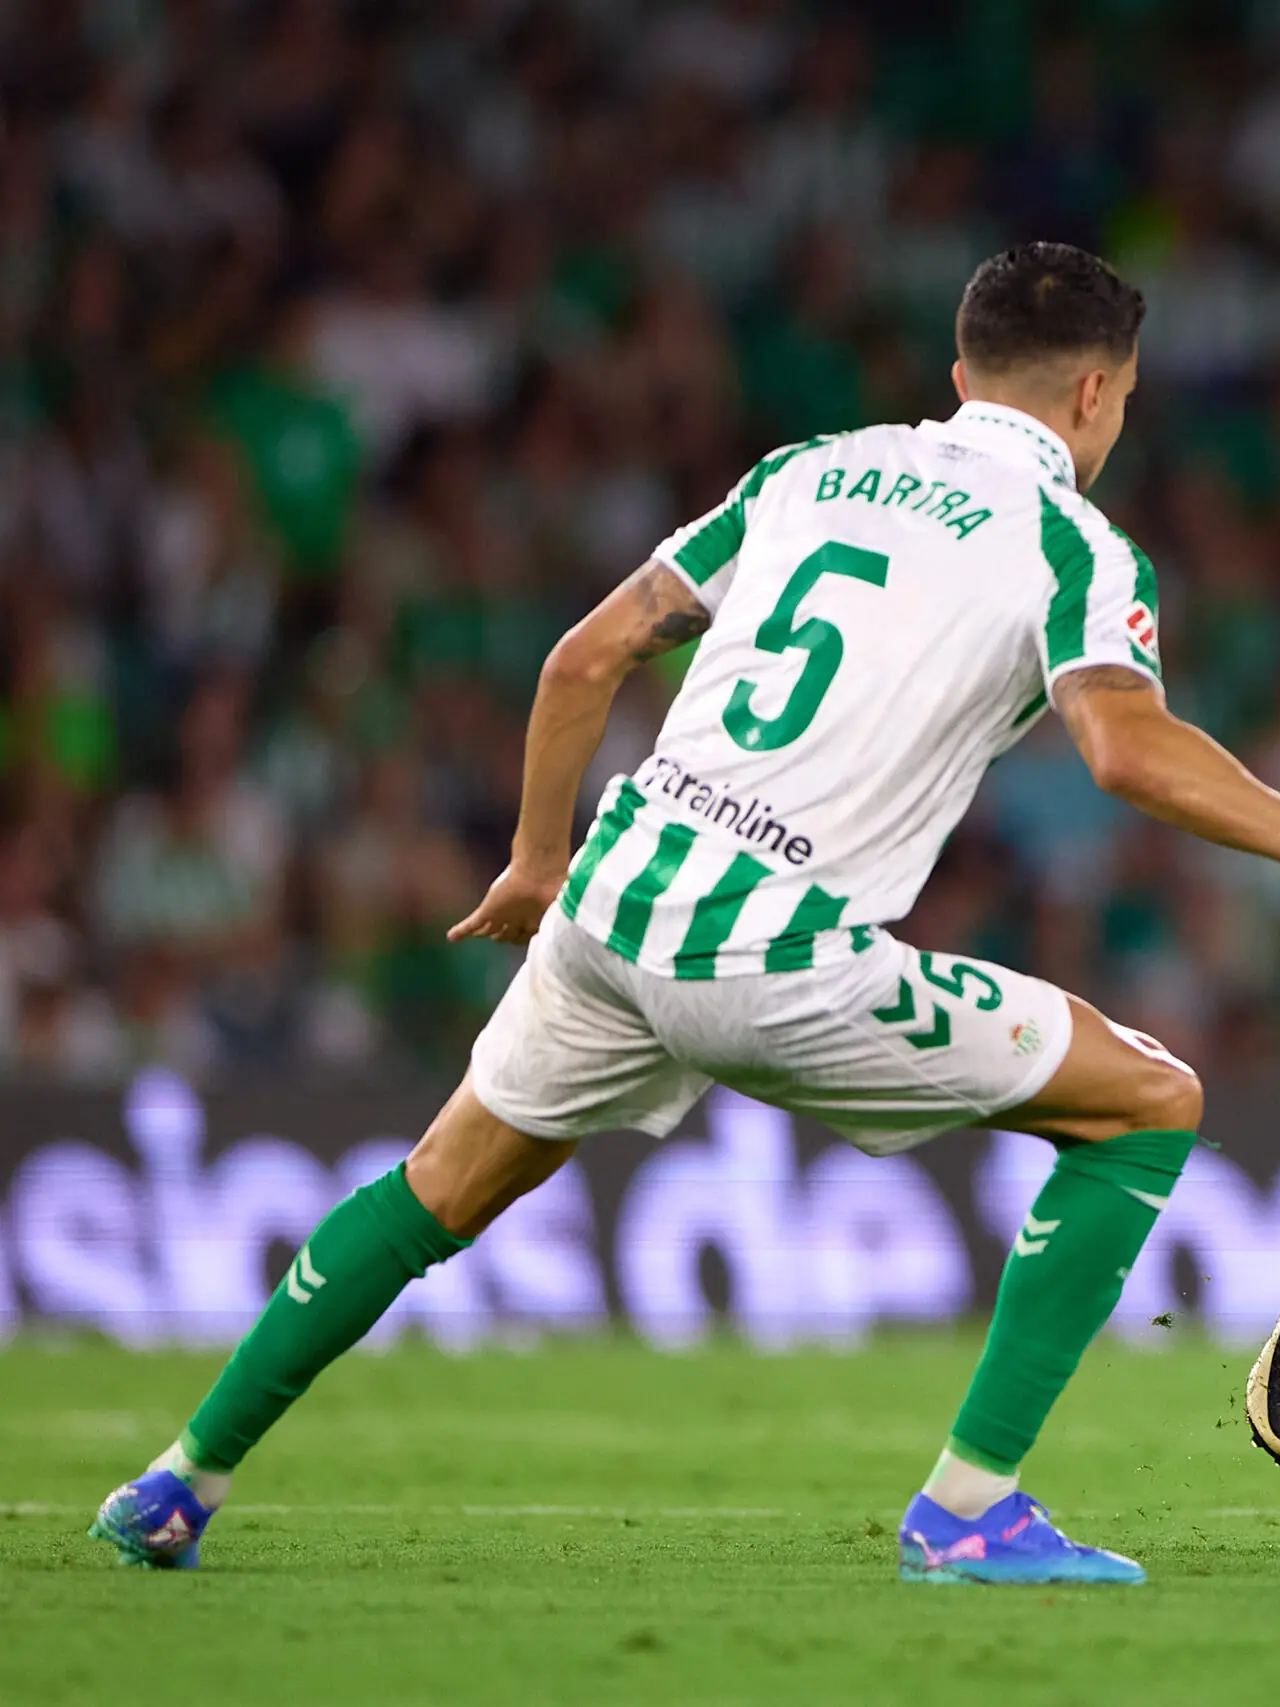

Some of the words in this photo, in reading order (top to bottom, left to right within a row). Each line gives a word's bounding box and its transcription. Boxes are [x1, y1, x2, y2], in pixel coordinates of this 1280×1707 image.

[815, 468, 993, 541] BARTRA
[721, 540, 891, 752] 5
[645, 757, 813, 866] trainline
[919, 951, 1004, 1012] 5
